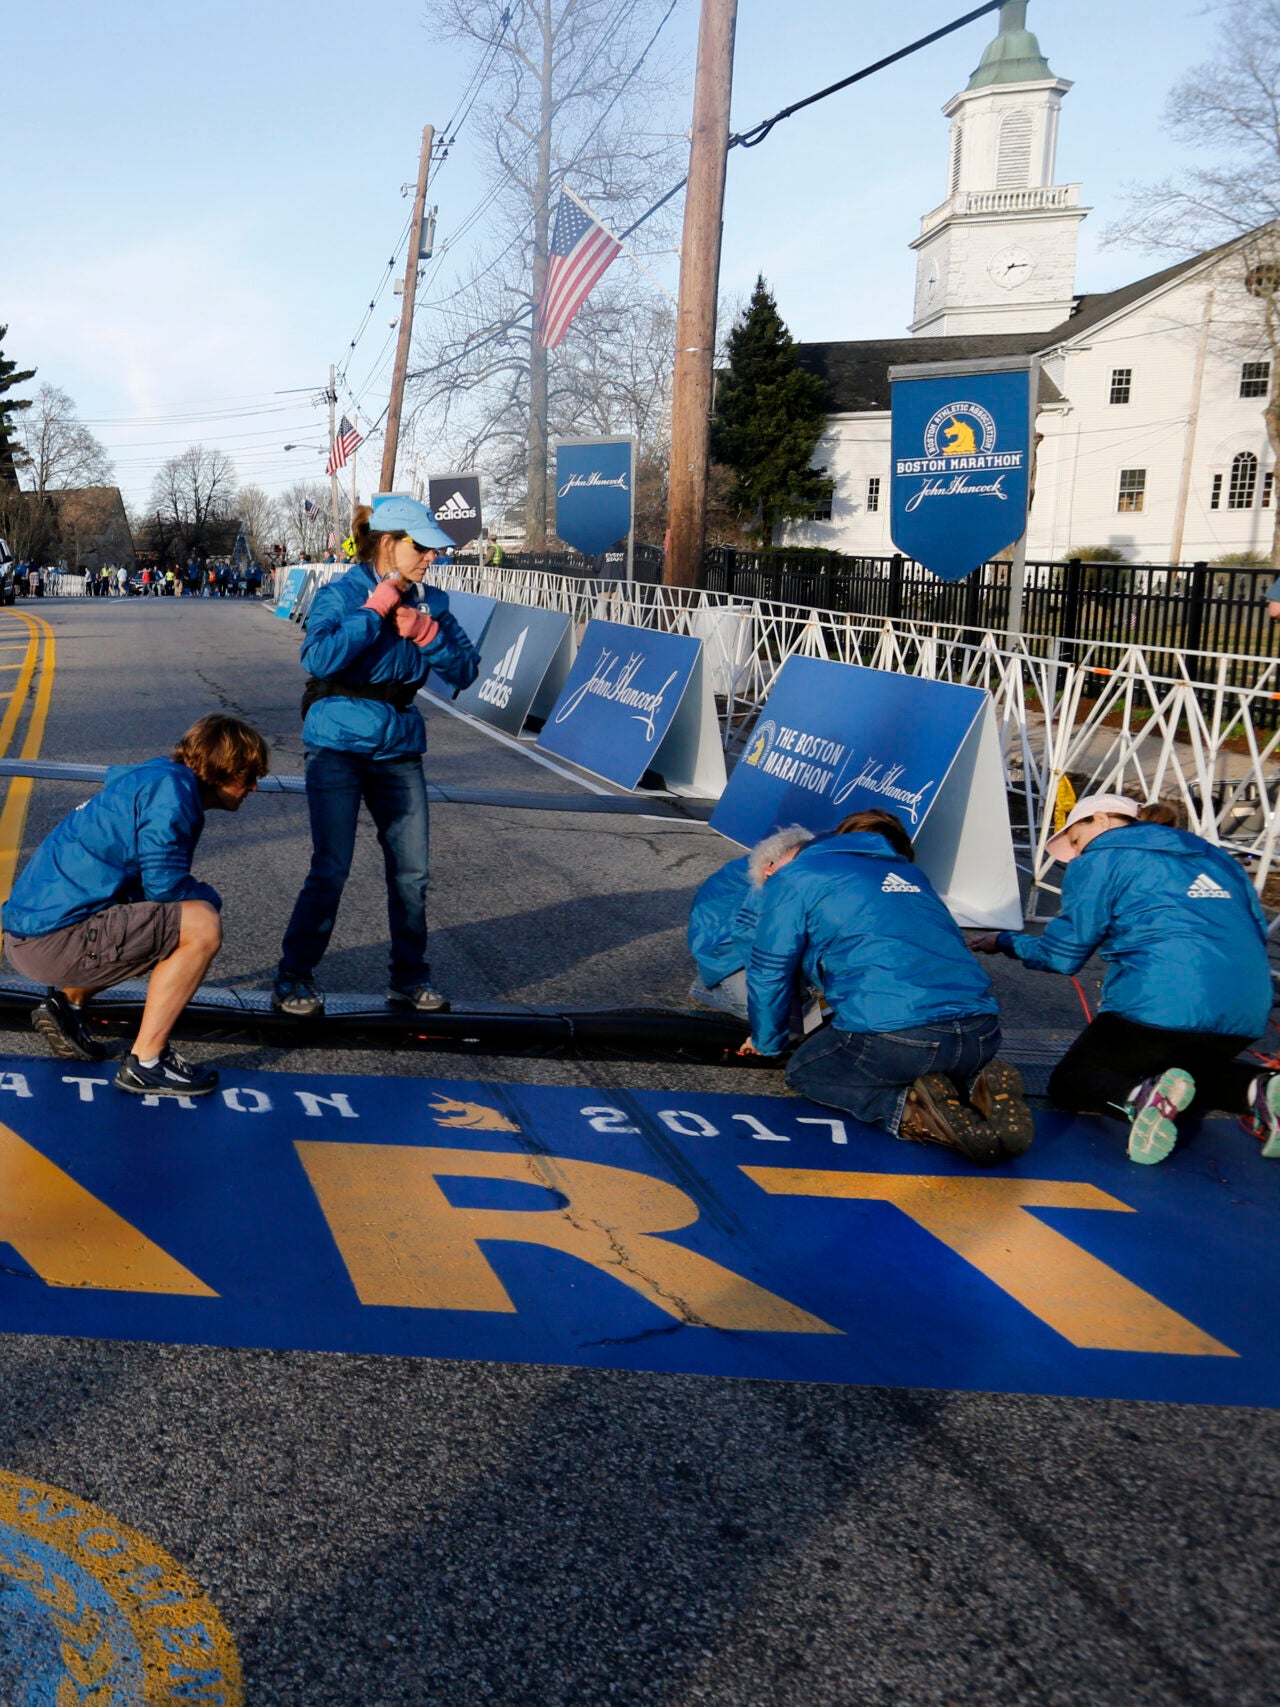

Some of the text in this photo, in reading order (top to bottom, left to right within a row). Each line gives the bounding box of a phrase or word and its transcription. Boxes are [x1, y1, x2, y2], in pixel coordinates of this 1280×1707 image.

[926, 403, 994, 454] BOSTON ATHLETIC ASSOCIATION
[896, 455, 1021, 474] BOSTON MARATHON
[557, 472, 629, 498] John Hancock
[905, 474, 1008, 512] John Hancock
[434, 509, 477, 521] adidas
[478, 674, 512, 709] adidas
[555, 647, 678, 742] John Hancock
[775, 726, 799, 750] THE
[794, 732, 845, 766] BOSTON
[763, 751, 834, 794] MARATHON
[833, 757, 934, 825] John Hancock
[881, 884, 921, 893] adidas
[1186, 889, 1232, 899] adidas
[578, 1105, 849, 1146] 2017
[18, 1487, 228, 1706] WOMEN
